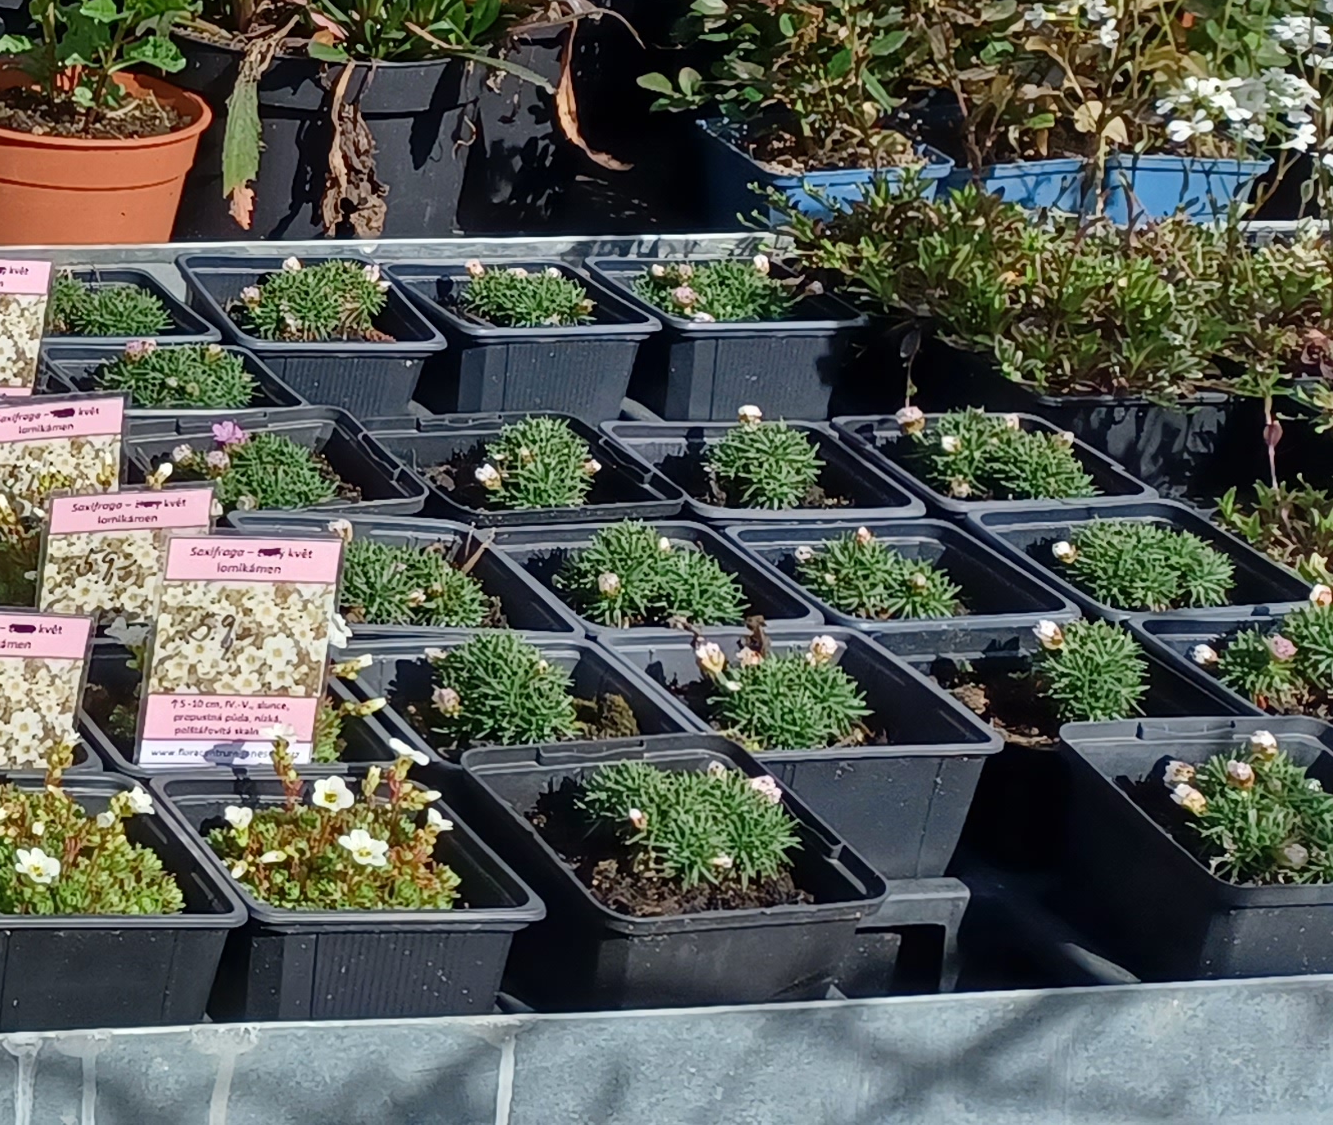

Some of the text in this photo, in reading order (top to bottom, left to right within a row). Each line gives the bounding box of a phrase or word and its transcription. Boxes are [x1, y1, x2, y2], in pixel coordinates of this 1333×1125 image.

[71, 501, 123, 512] Saxifraga
[97, 515, 158, 525] lomikámen
[190, 546, 245, 559] Saxifraga
[288, 548, 313, 559] květ
[217, 562, 282, 575] lomikámen
[38, 624, 63, 635] květ
[173, 713, 223, 723] propustná
[225, 713, 251, 723] půda,
